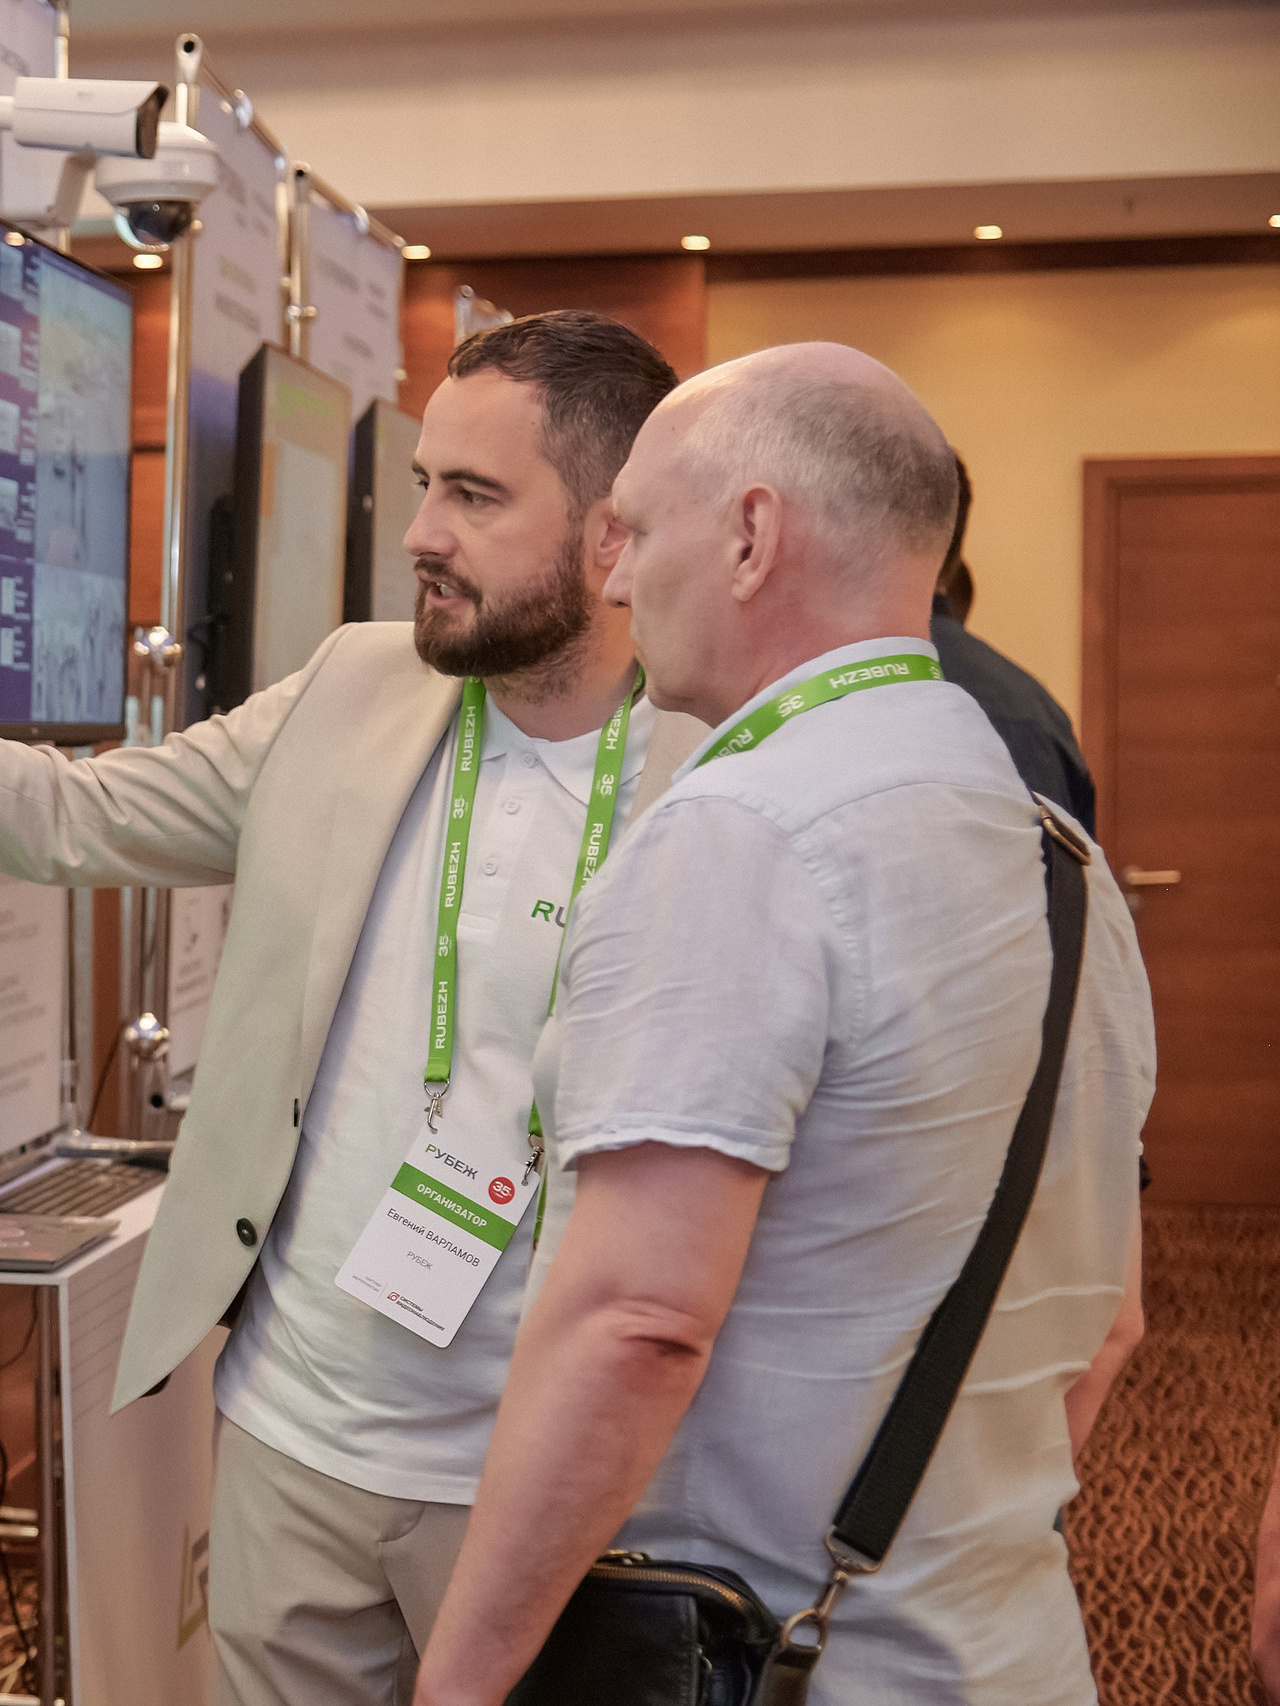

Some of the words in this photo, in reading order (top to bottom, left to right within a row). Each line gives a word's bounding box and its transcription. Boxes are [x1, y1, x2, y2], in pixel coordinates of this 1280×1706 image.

[829, 662, 911, 689] RUBEZH
[777, 694, 805, 718] 35
[461, 705, 476, 772] RUBEZH
[601, 773, 615, 796] 35
[453, 796, 466, 819] 35
[444, 841, 461, 908] RUBEZH
[438, 933, 449, 957] 35
[435, 980, 449, 1050] RUBEZH
[425, 1143, 479, 1180] РУБЕЖ
[492, 1180, 512, 1197] 35
[416, 1183, 488, 1229] ОРГАНИЗАТОР
[387, 1207, 425, 1236] Евгений
[425, 1229, 480, 1268] ВАРЛАМОВ
[406, 1251, 433, 1271] РУБЕЖ
[400, 1295, 424, 1312] СИСТЕМЫ
